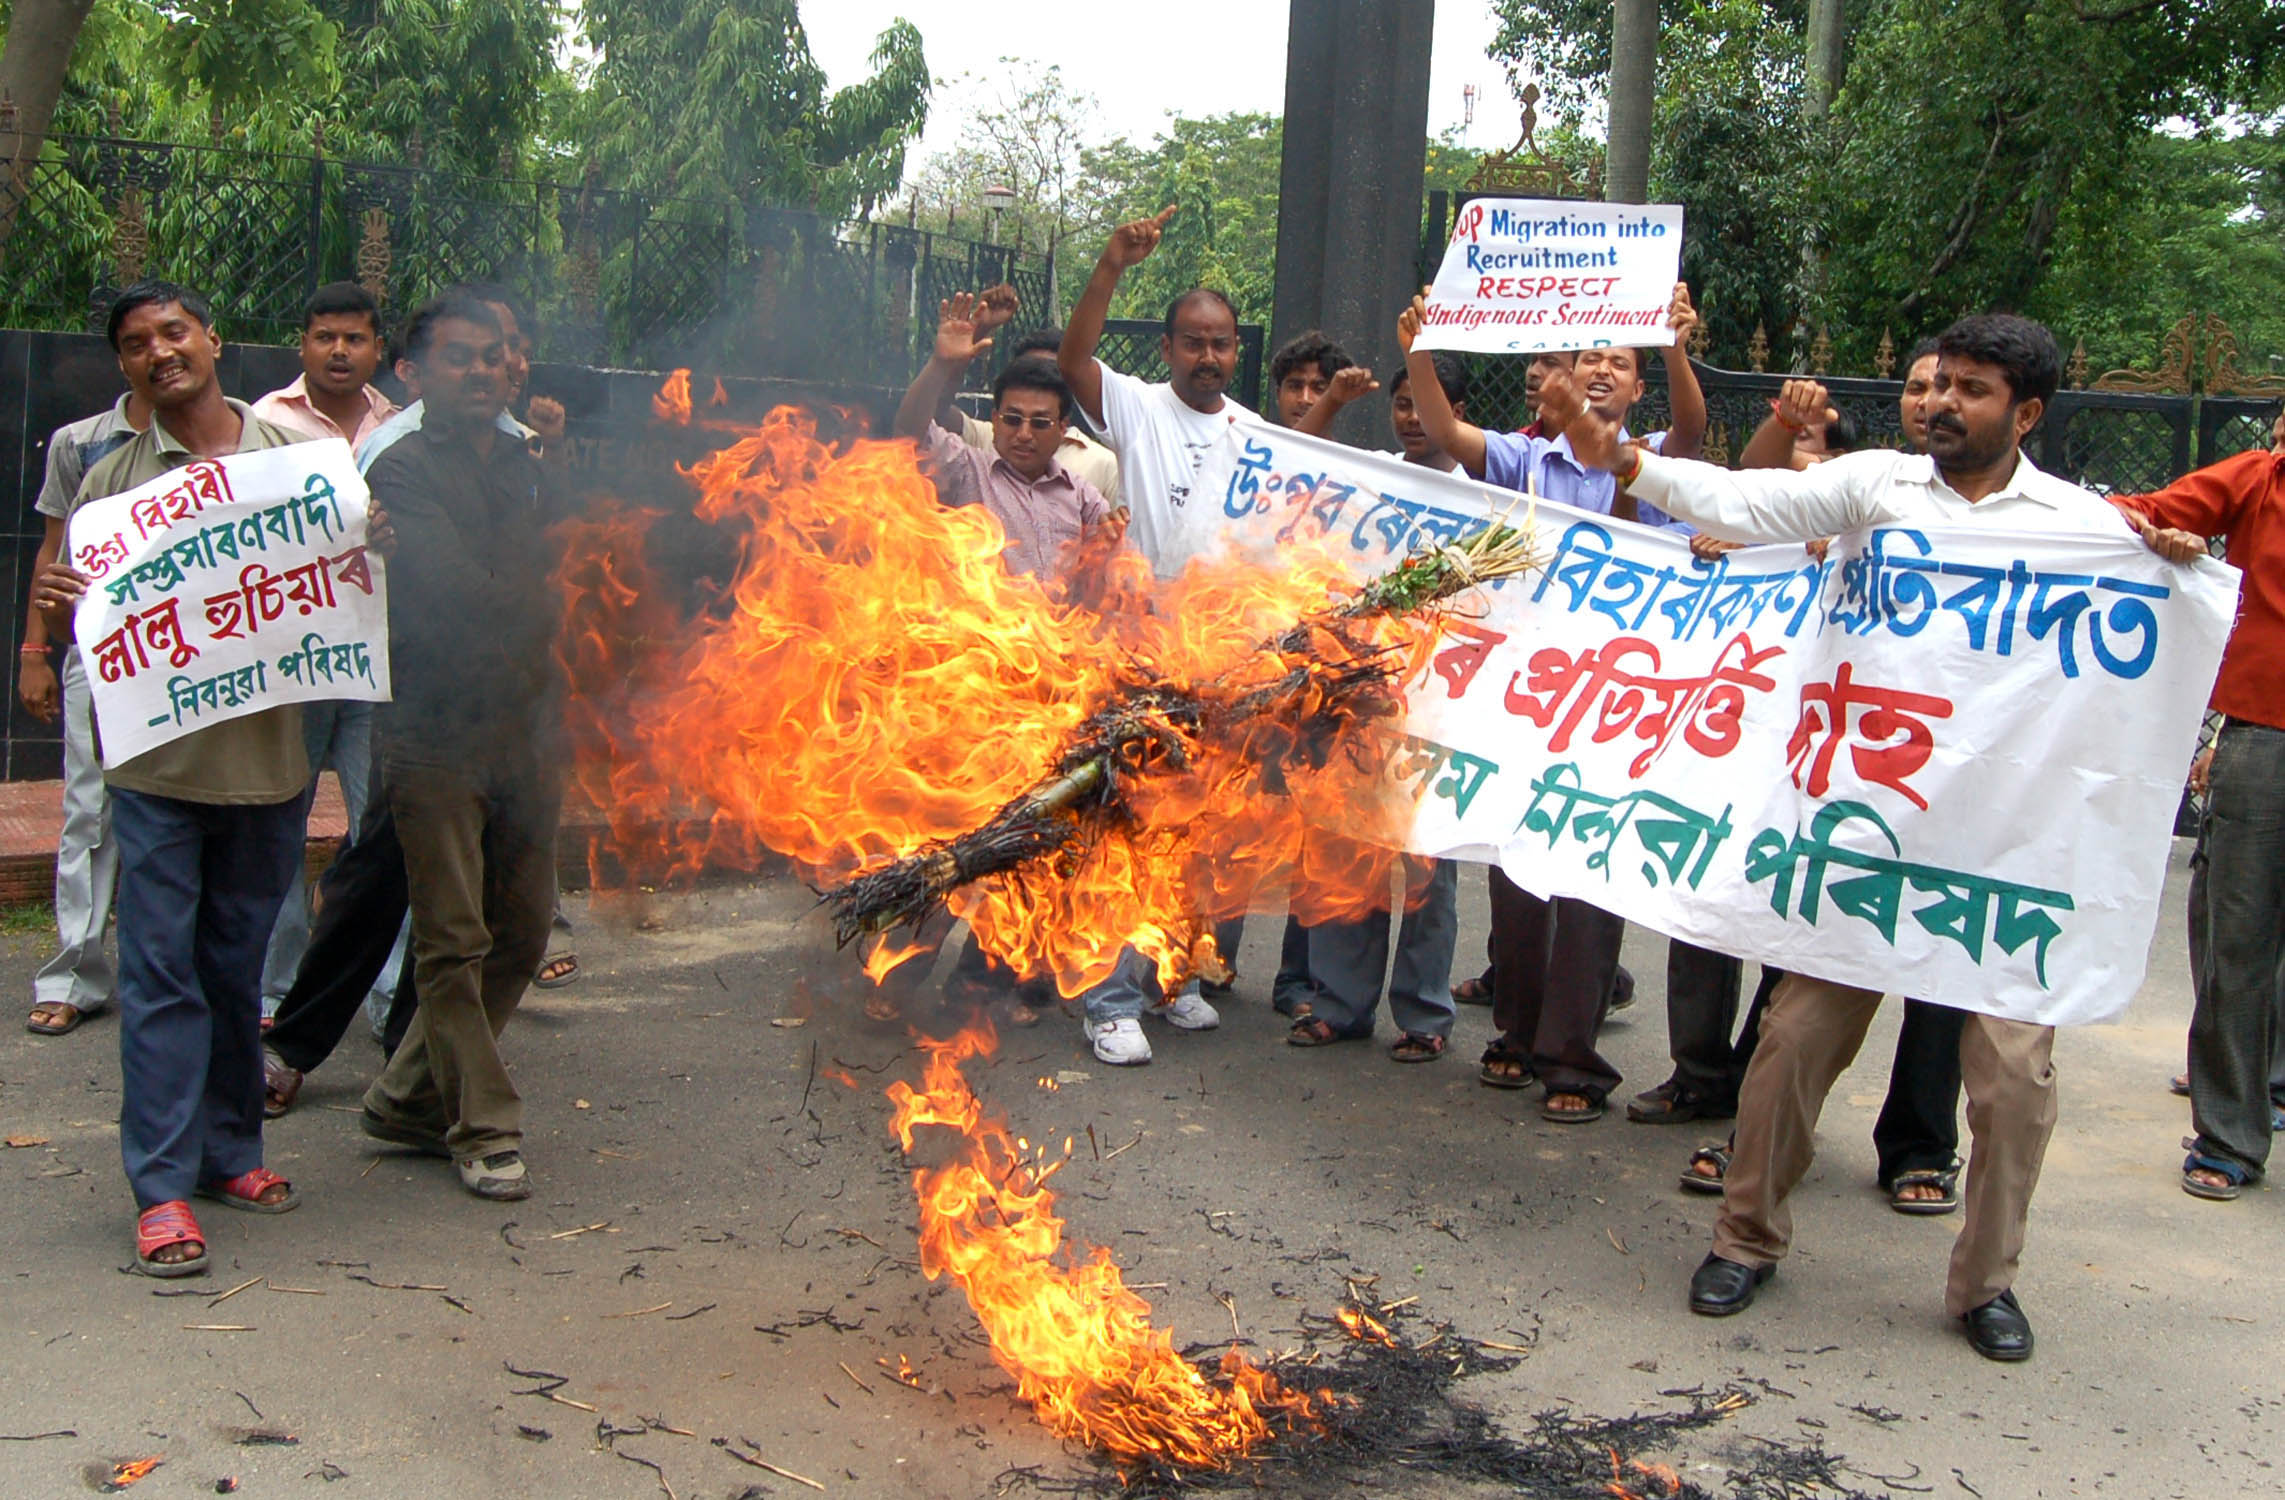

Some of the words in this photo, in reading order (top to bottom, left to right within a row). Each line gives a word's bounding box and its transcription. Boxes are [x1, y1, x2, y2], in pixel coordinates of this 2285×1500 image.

[1490, 209, 1606, 244] Migration
[1618, 214, 1666, 238] into
[1466, 244, 1618, 275] Recruitment
[1475, 276, 1622, 299] RESPECT
[1421, 303, 1548, 331] Indigenous
[1551, 302, 1664, 326] Sentiment
[92, 597, 200, 684] লালু
